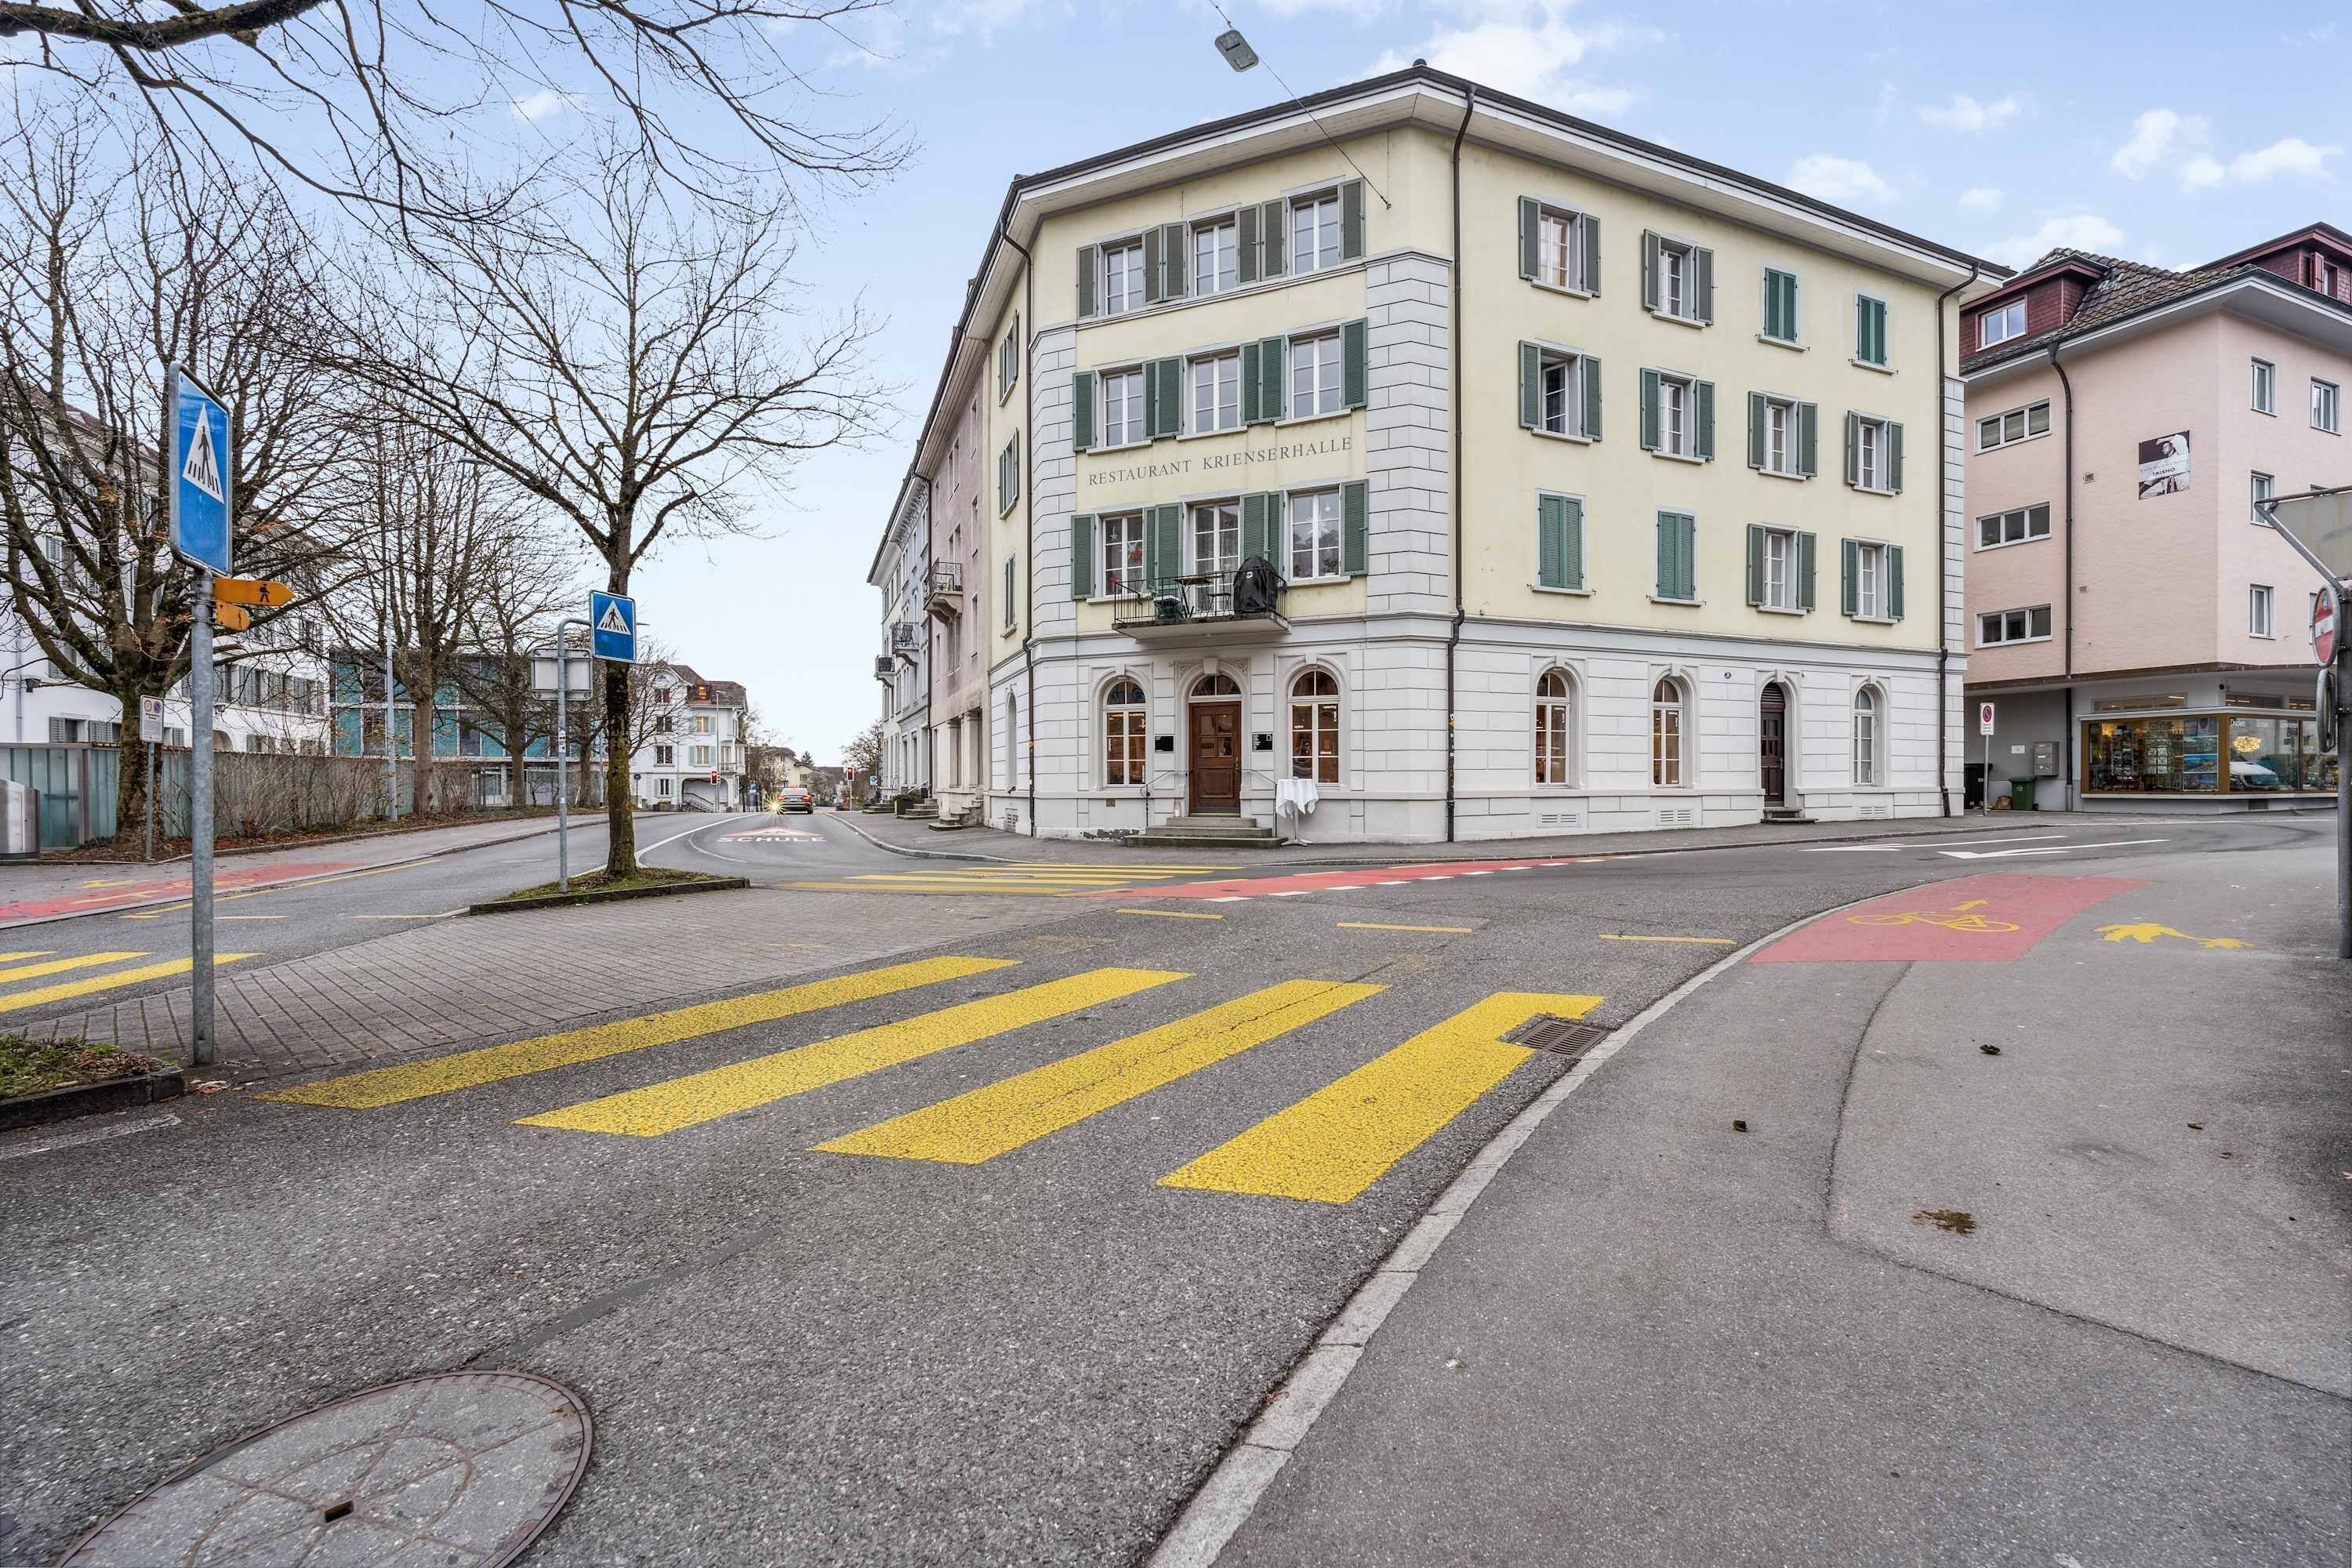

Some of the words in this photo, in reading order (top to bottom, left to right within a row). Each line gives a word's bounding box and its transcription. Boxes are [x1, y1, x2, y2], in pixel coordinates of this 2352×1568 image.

[1088, 459, 1192, 486] RESTAURANT
[1203, 437, 1352, 470] KRIENSERHALLE
[2152, 467, 2175, 476] TAISHO
